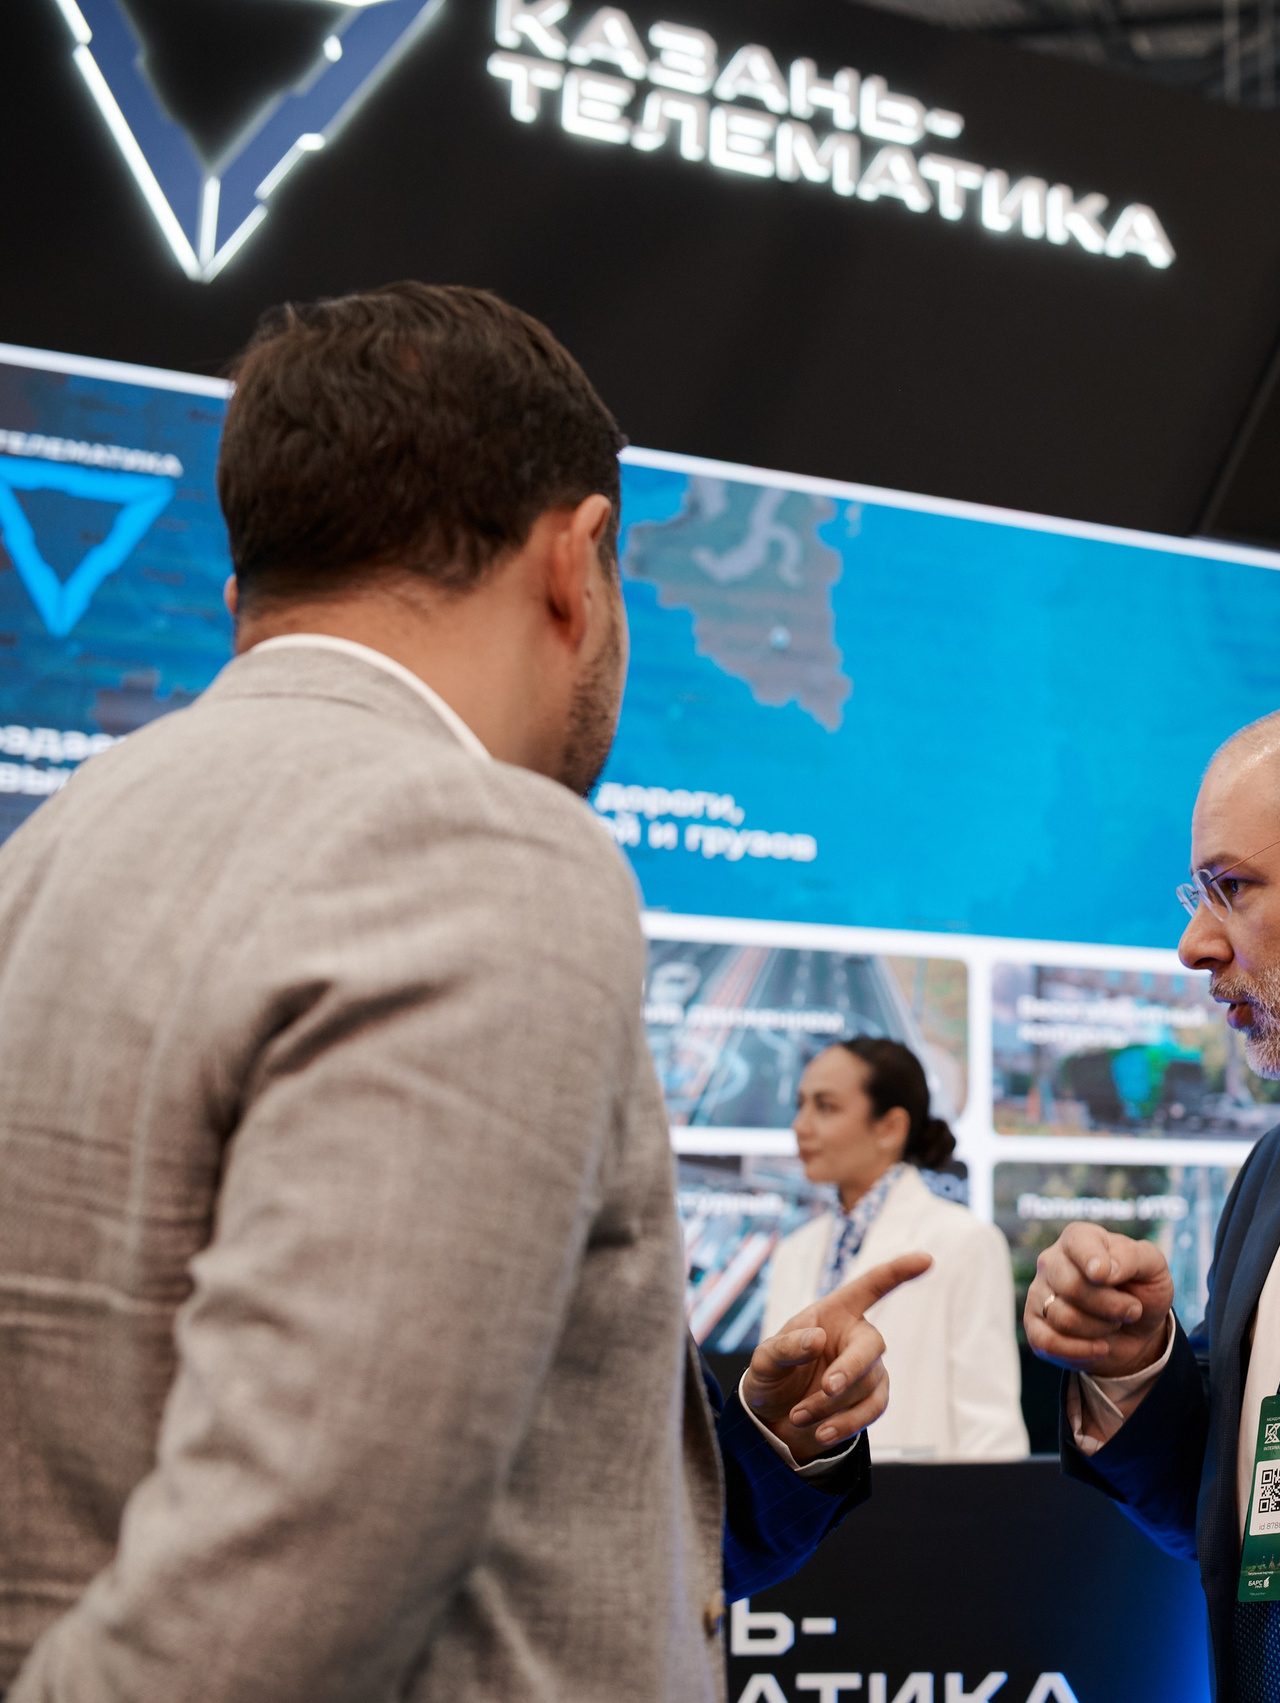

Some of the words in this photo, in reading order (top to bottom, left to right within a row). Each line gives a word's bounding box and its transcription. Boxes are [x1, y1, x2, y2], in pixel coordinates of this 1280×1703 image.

[494, 0, 964, 144] КАЗАНЬ-
[487, 53, 1176, 269] ТЕЛЕМАТИКА
[685, 824, 817, 862] грузов
